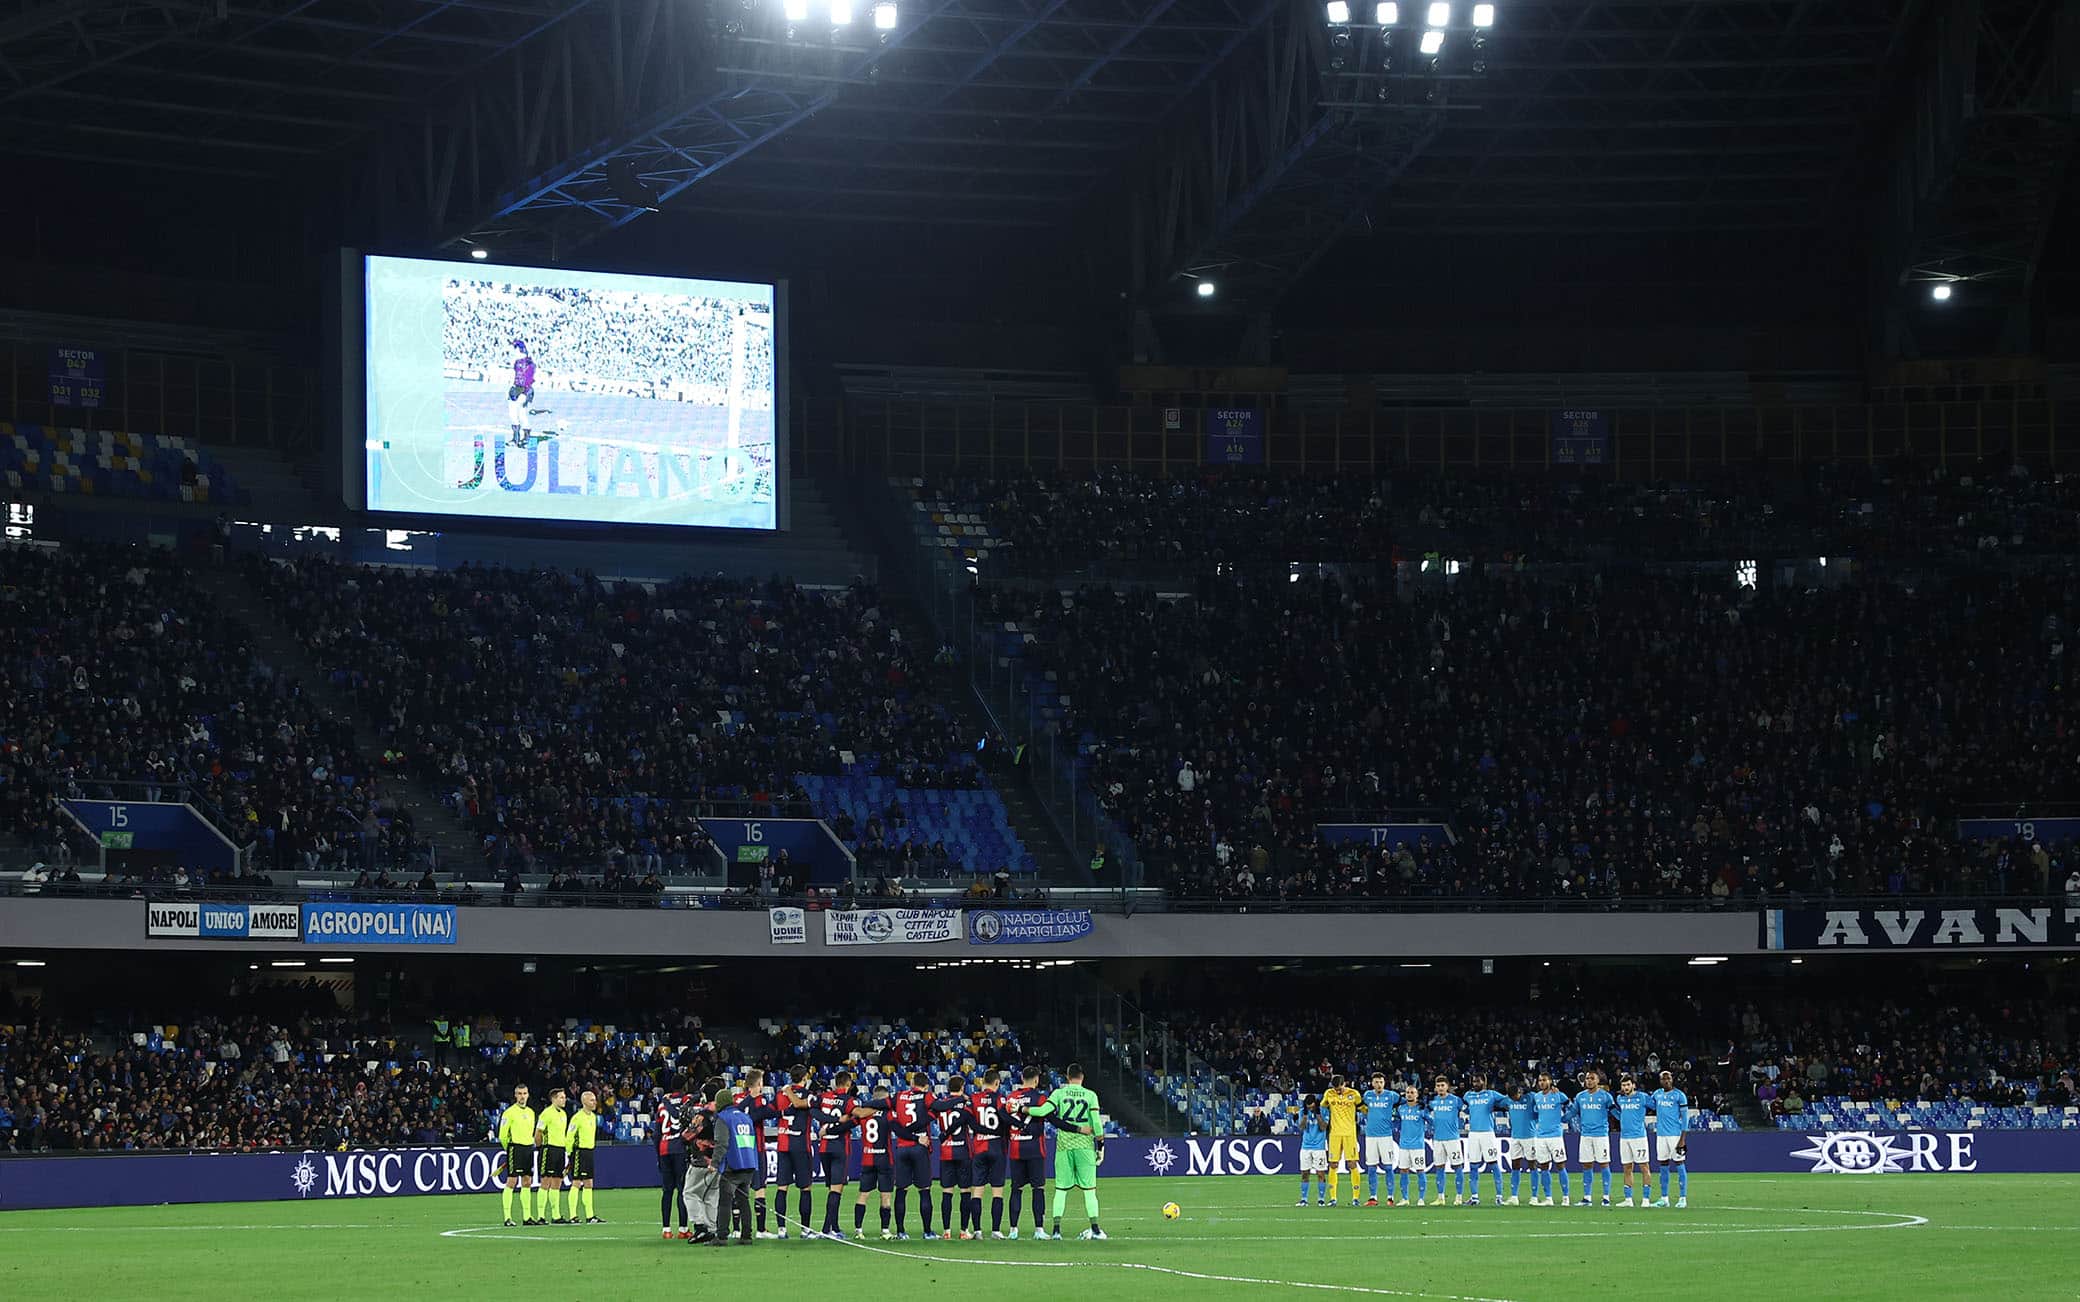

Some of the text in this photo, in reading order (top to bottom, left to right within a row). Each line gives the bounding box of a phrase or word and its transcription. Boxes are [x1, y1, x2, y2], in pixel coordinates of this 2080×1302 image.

[57, 349, 95, 360] SECTOR
[1217, 410, 1251, 420] SECTOR
[1562, 410, 1597, 420] SECTOR
[108, 806, 129, 828] 15
[743, 822, 764, 842] 16
[1370, 827, 1388, 847] 17
[2014, 822, 2035, 841] 18
[150, 910, 297, 930] NAPOLI UNICO AMORE
[895, 909, 956, 919] CLUB NAPOLI
[1004, 913, 1054, 926] NAPOLI
[307, 910, 452, 939] AGROPOLI (NA)
[773, 926, 803, 935] UDINE
[836, 922, 854, 931] CLUB
[937, 920, 949, 929] DI
[1006, 921, 1090, 938] MARIGLIANO
[834, 932, 858, 941] IMOLA
[906, 930, 950, 940] CASTELLO
[905, 1103, 917, 1127] 3
[1062, 1098, 1089, 1122] 22
[977, 1106, 999, 1130] 16
[865, 1118, 879, 1143] 8
[1185, 1138, 1283, 1175] MSC
[1554, 1148, 1564, 1157] 24
[1636, 1150, 1646, 1158] 77
[1414, 1157, 1424, 1165] 68
[324, 1153, 402, 1196] MSC
